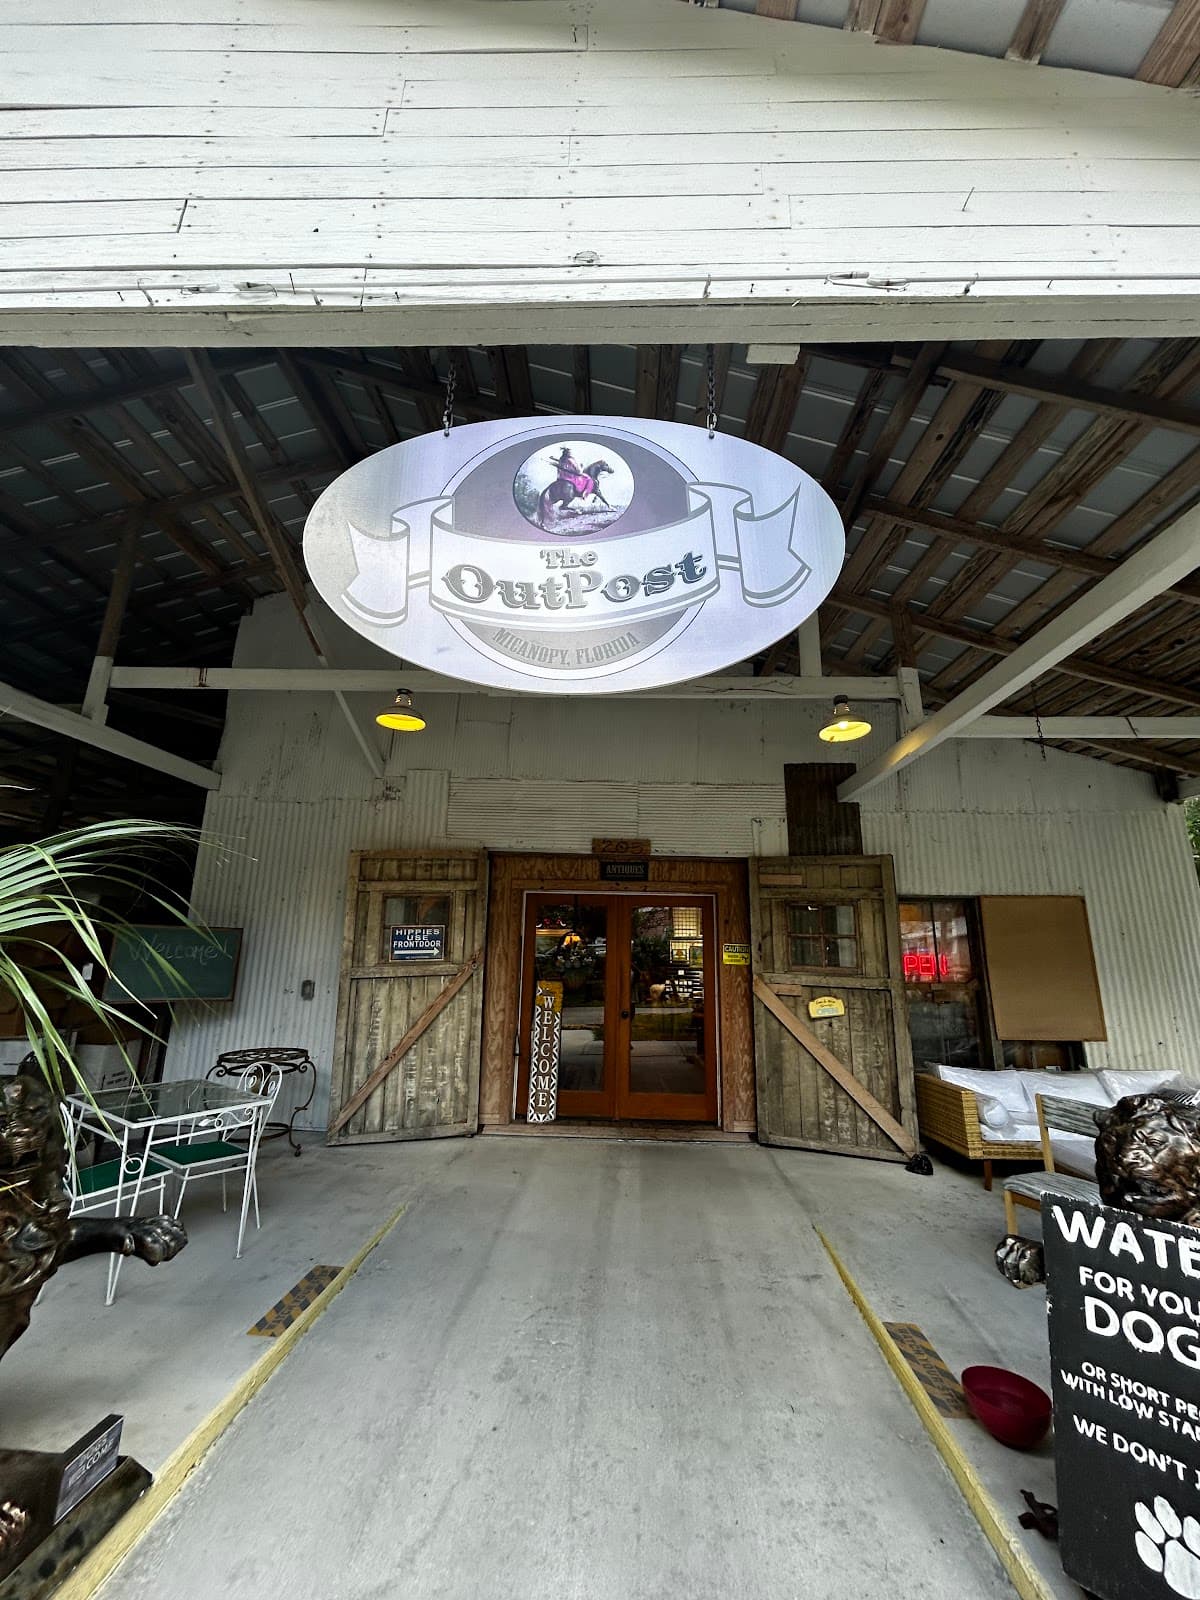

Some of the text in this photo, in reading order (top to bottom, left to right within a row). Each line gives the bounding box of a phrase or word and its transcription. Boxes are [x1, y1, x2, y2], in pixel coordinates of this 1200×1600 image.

[441, 551, 706, 610] OutPost
[540, 548, 598, 569] The
[491, 628, 640, 666] MICANOPY, FLORIDA
[395, 928, 440, 936] HIPPIES
[724, 945, 749, 953] CAUTION
[537, 995, 555, 1108] WELCOME
[1079, 1266, 1135, 1302] FOR
[1060, 1369, 1105, 1400] WITH
[1108, 1389, 1153, 1419] LOW
[1081, 1361, 1200, 1420] OR SHORT PE
[1073, 1414, 1108, 1446] WE
[1113, 1433, 1187, 1481] DON'T
